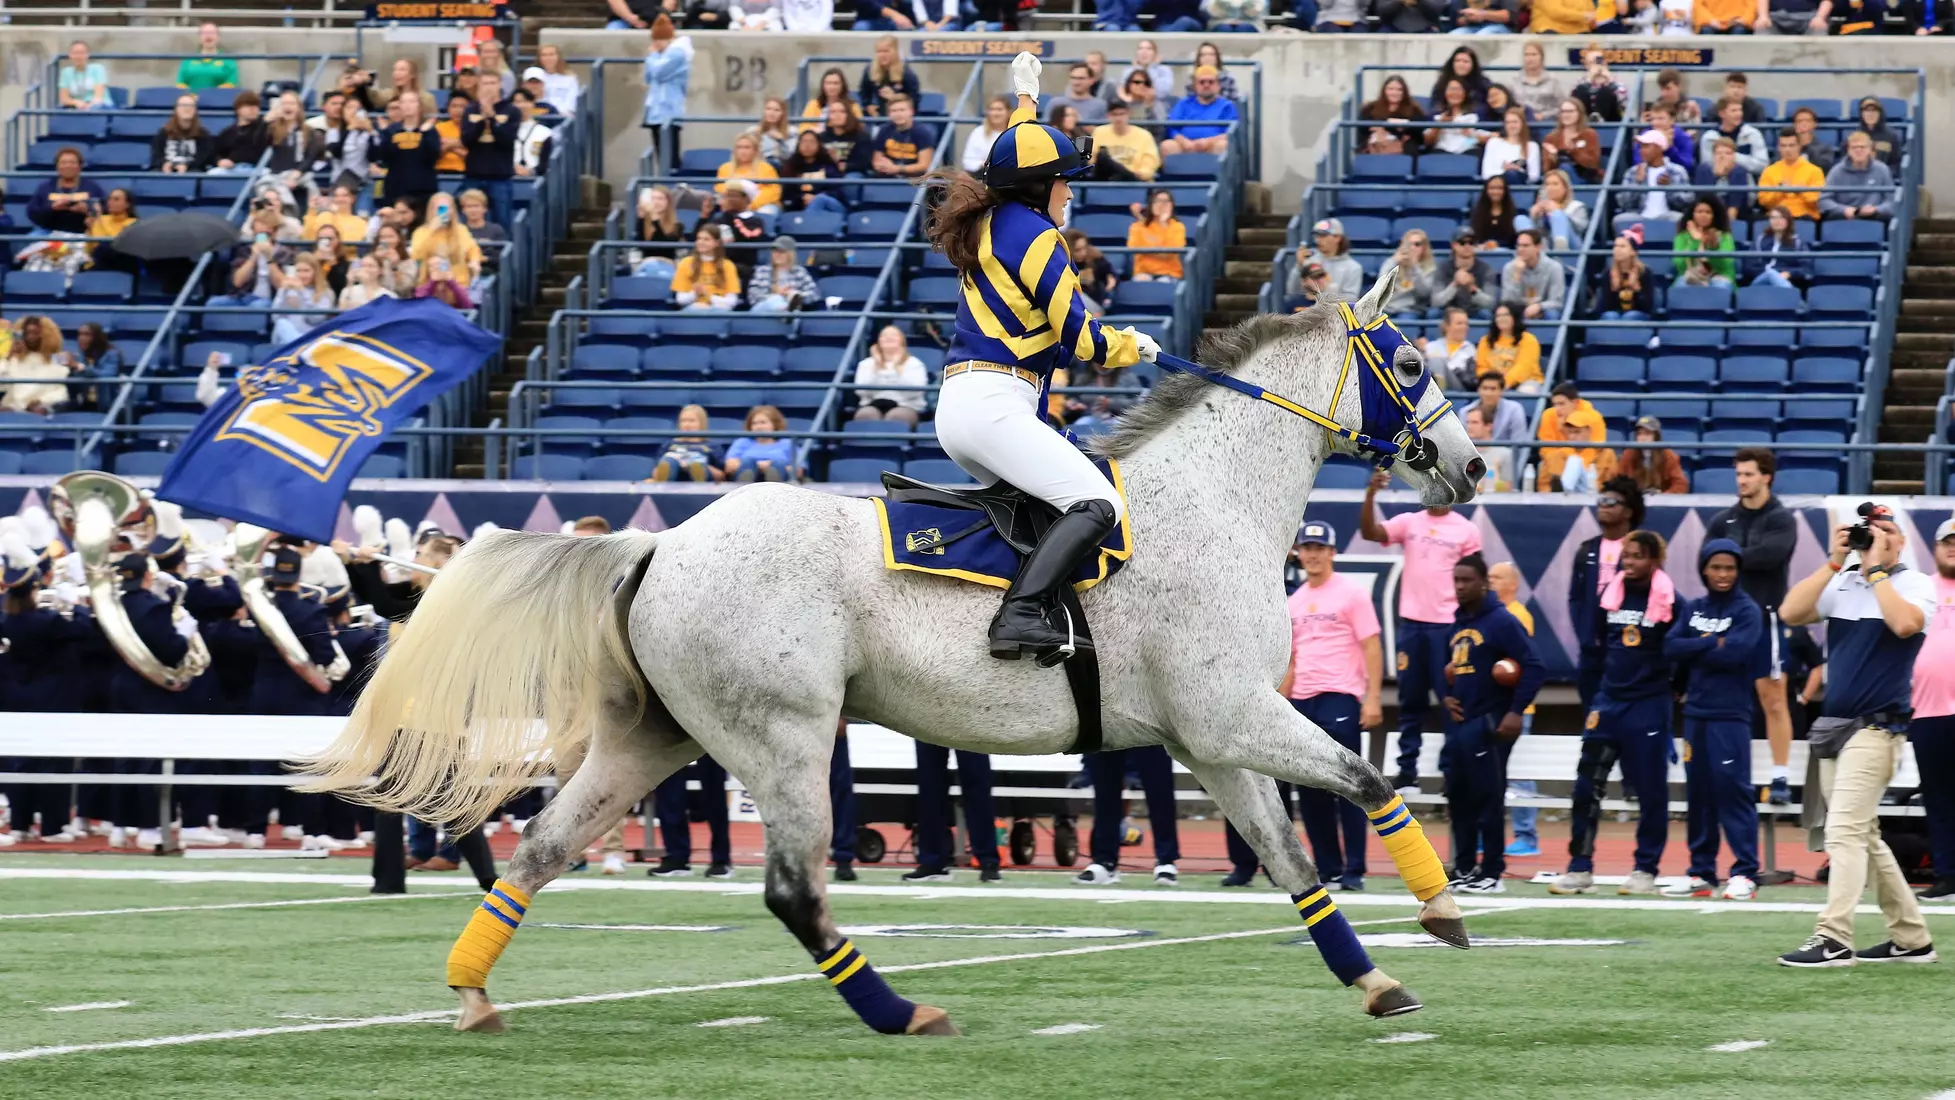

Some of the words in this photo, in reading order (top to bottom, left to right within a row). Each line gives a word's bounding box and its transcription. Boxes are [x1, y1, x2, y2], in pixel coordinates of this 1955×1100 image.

[376, 4, 437, 17] STUDENT
[440, 4, 497, 17] SEATING
[922, 40, 986, 54] STUDENT
[987, 41, 1043, 55] SEATING
[1580, 50, 1641, 63] SDENT
[1643, 50, 1703, 63] SEATING
[724, 55, 768, 92] BB
